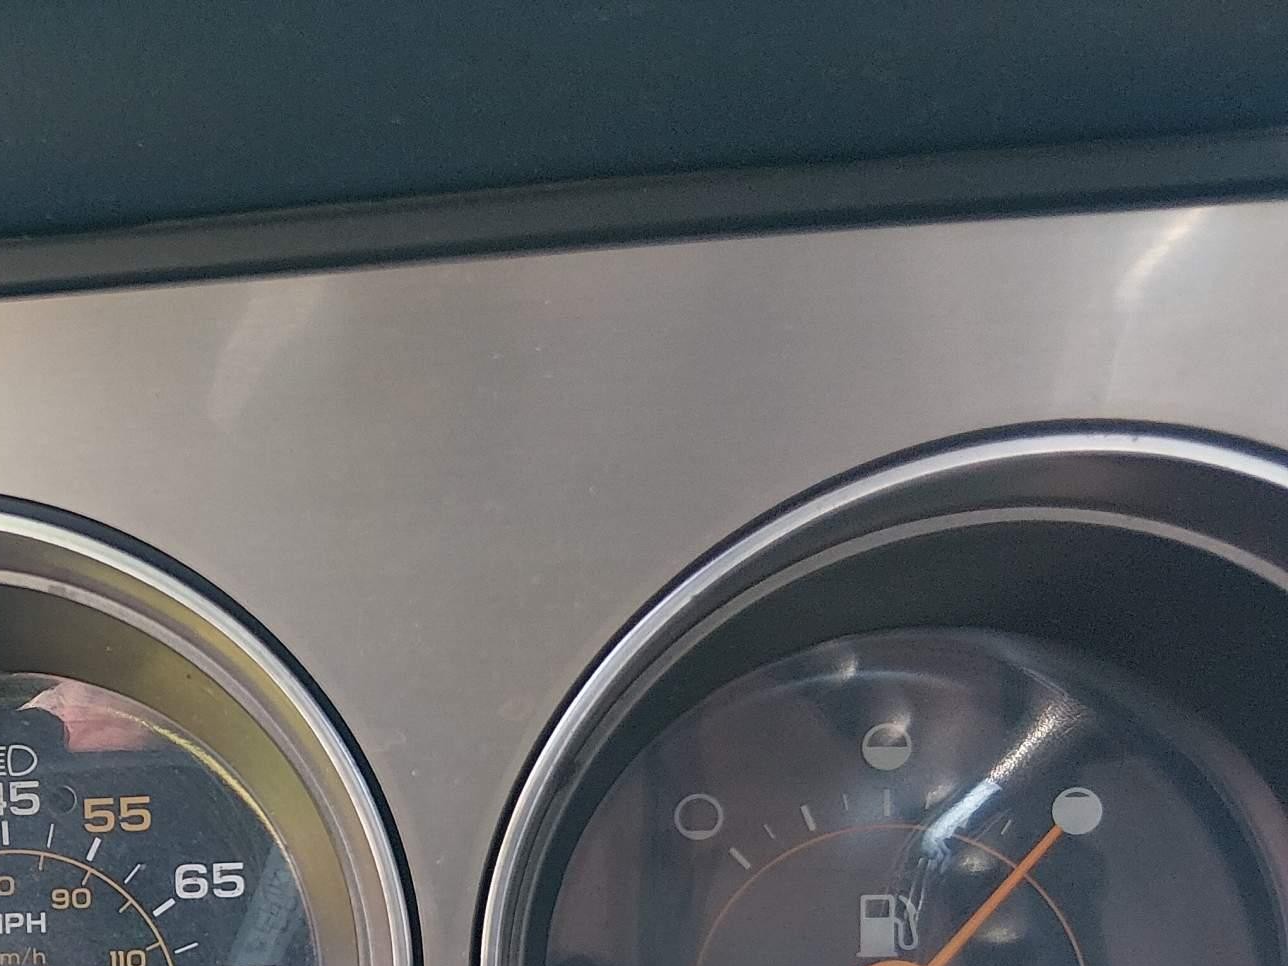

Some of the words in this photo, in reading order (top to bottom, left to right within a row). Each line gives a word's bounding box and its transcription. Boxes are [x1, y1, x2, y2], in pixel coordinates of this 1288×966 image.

[83, 796, 152, 832] 55
[50, 887, 93, 910] 90
[174, 862, 245, 900] 65
